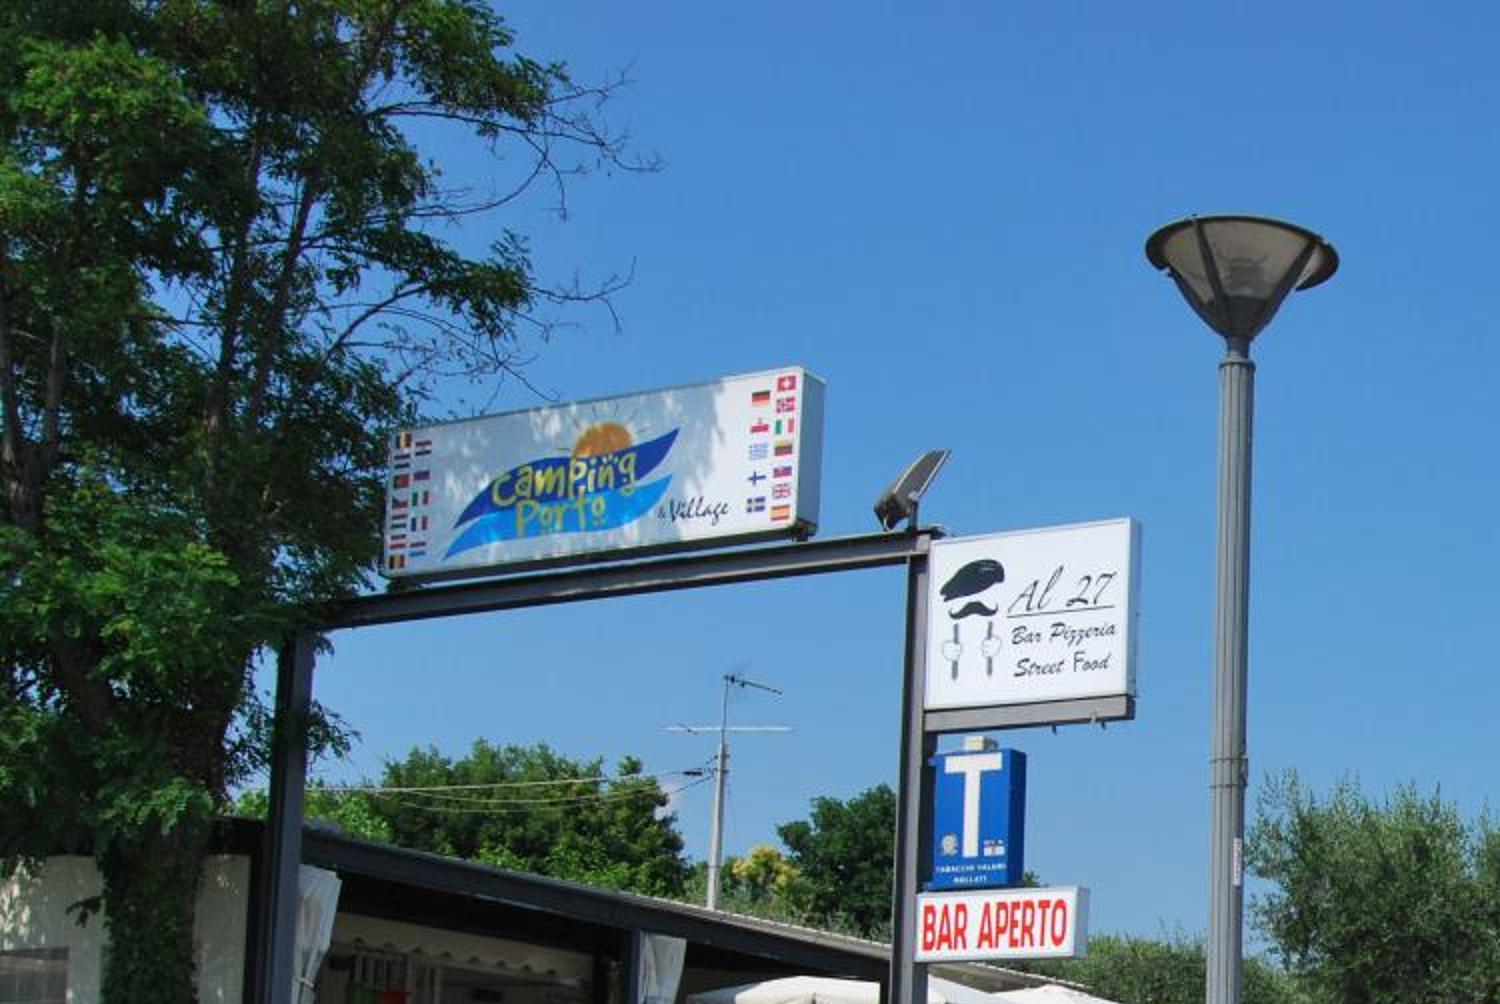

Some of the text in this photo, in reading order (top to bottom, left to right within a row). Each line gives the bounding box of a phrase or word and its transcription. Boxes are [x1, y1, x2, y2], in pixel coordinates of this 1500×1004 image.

[492, 452, 637, 507] Camping
[516, 488, 607, 538] Porto
[669, 496, 729, 527] Village
[1007, 565, 1118, 614] Al 27
[1012, 621, 1116, 647] Bar Pizzeria
[1014, 651, 1112, 678] Street Food
[944, 752, 1003, 858] T
[922, 898, 1068, 951] BAR APERTO
